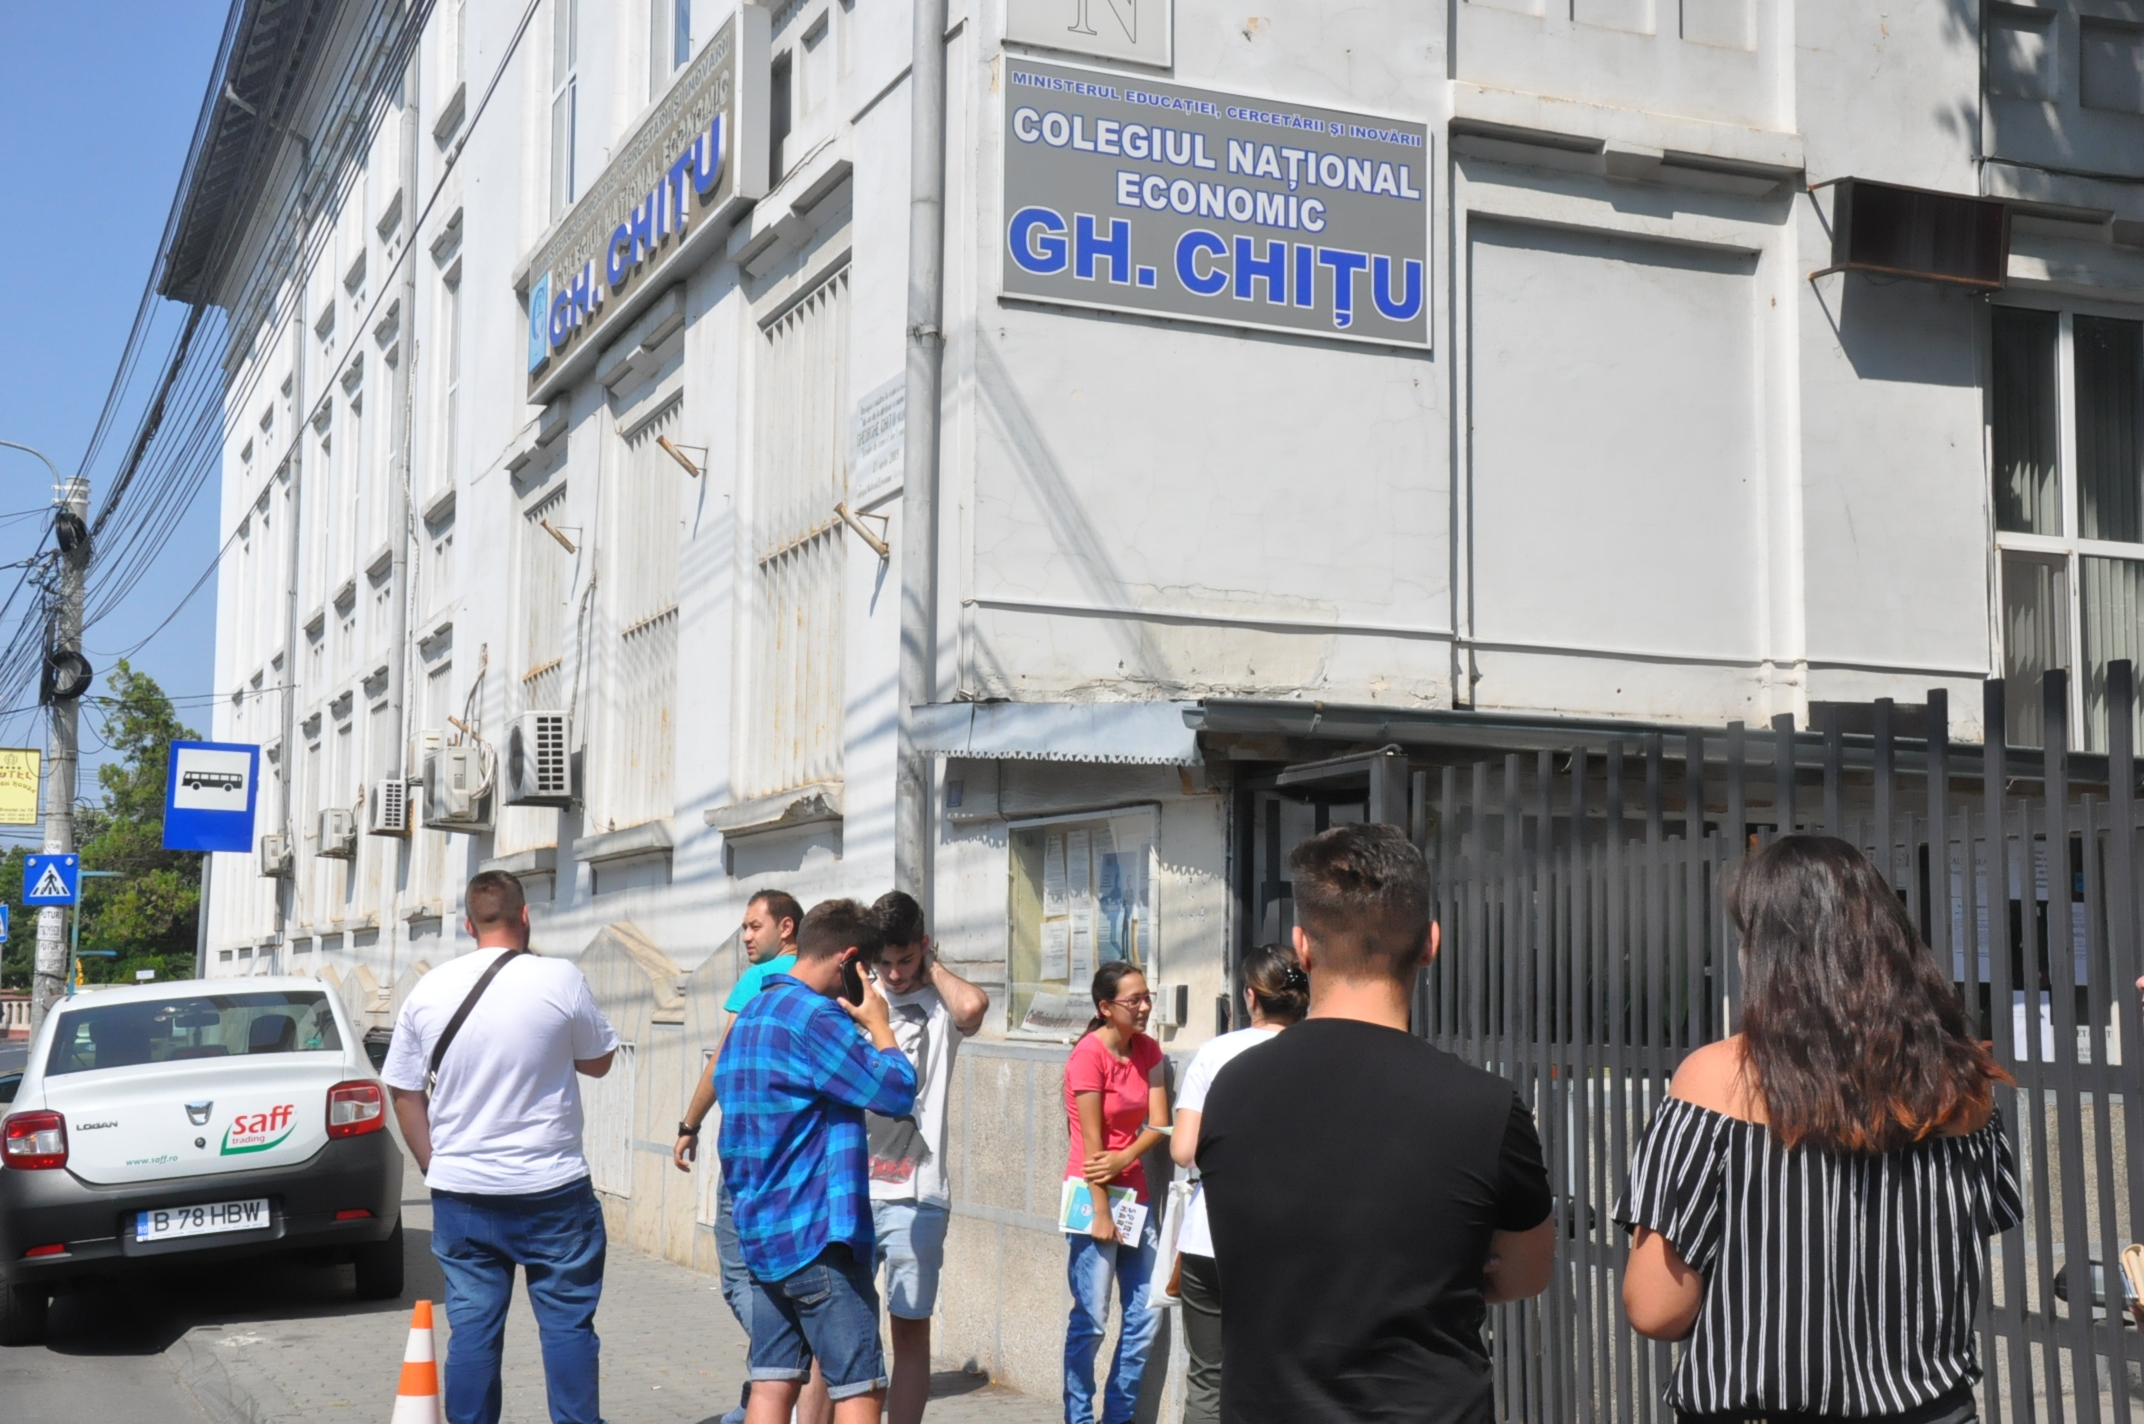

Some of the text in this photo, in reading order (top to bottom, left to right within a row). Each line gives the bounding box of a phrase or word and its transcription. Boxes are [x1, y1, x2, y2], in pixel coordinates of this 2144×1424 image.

[1012, 71, 1121, 101] MINISTERUL
[1226, 105, 1325, 134] CERCETĂRII
[1329, 121, 1346, 139] ȘI
[1350, 125, 1423, 148] INOVĂRII
[1012, 106, 1422, 201] COLEGIUL NAȚIONAL
[1116, 170, 1326, 232] ECONOMIC
[1008, 205, 1424, 329] GH. CHIȚU
[548, 259, 603, 348] GH.
[76, 1121, 119, 1131] LOGAN
[232, 1104, 295, 1136] saff
[232, 1135, 266, 1145] trading
[125, 1154, 178, 1166] www.saff.ro
[137, 1225, 148, 1236] RO
[154, 1211, 170, 1232] B
[178, 1207, 205, 1230] 78
[210, 1201, 261, 1226] HBW
